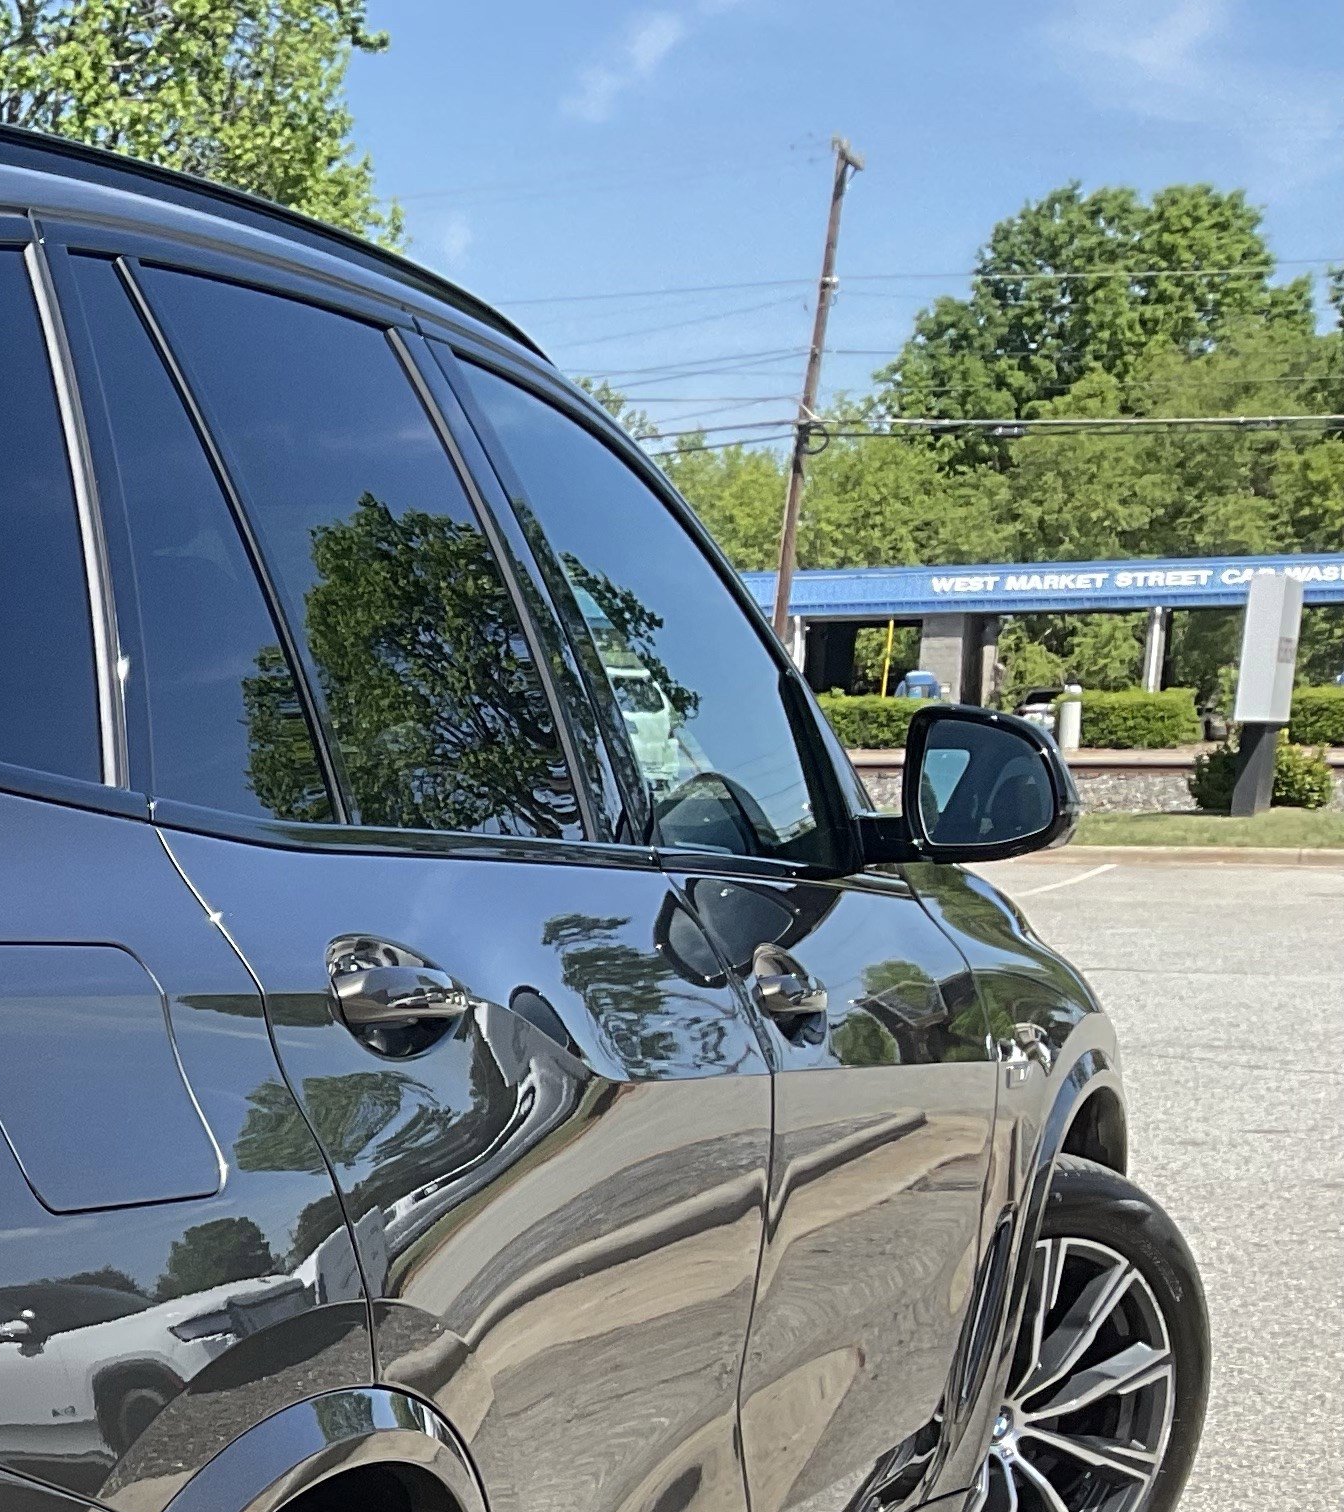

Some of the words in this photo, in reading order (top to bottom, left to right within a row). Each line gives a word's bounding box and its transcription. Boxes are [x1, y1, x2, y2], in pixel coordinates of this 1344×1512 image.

[932, 576, 1000, 592] WEST
[1004, 573, 1109, 591] MARKET
[1114, 569, 1213, 588] STREET
